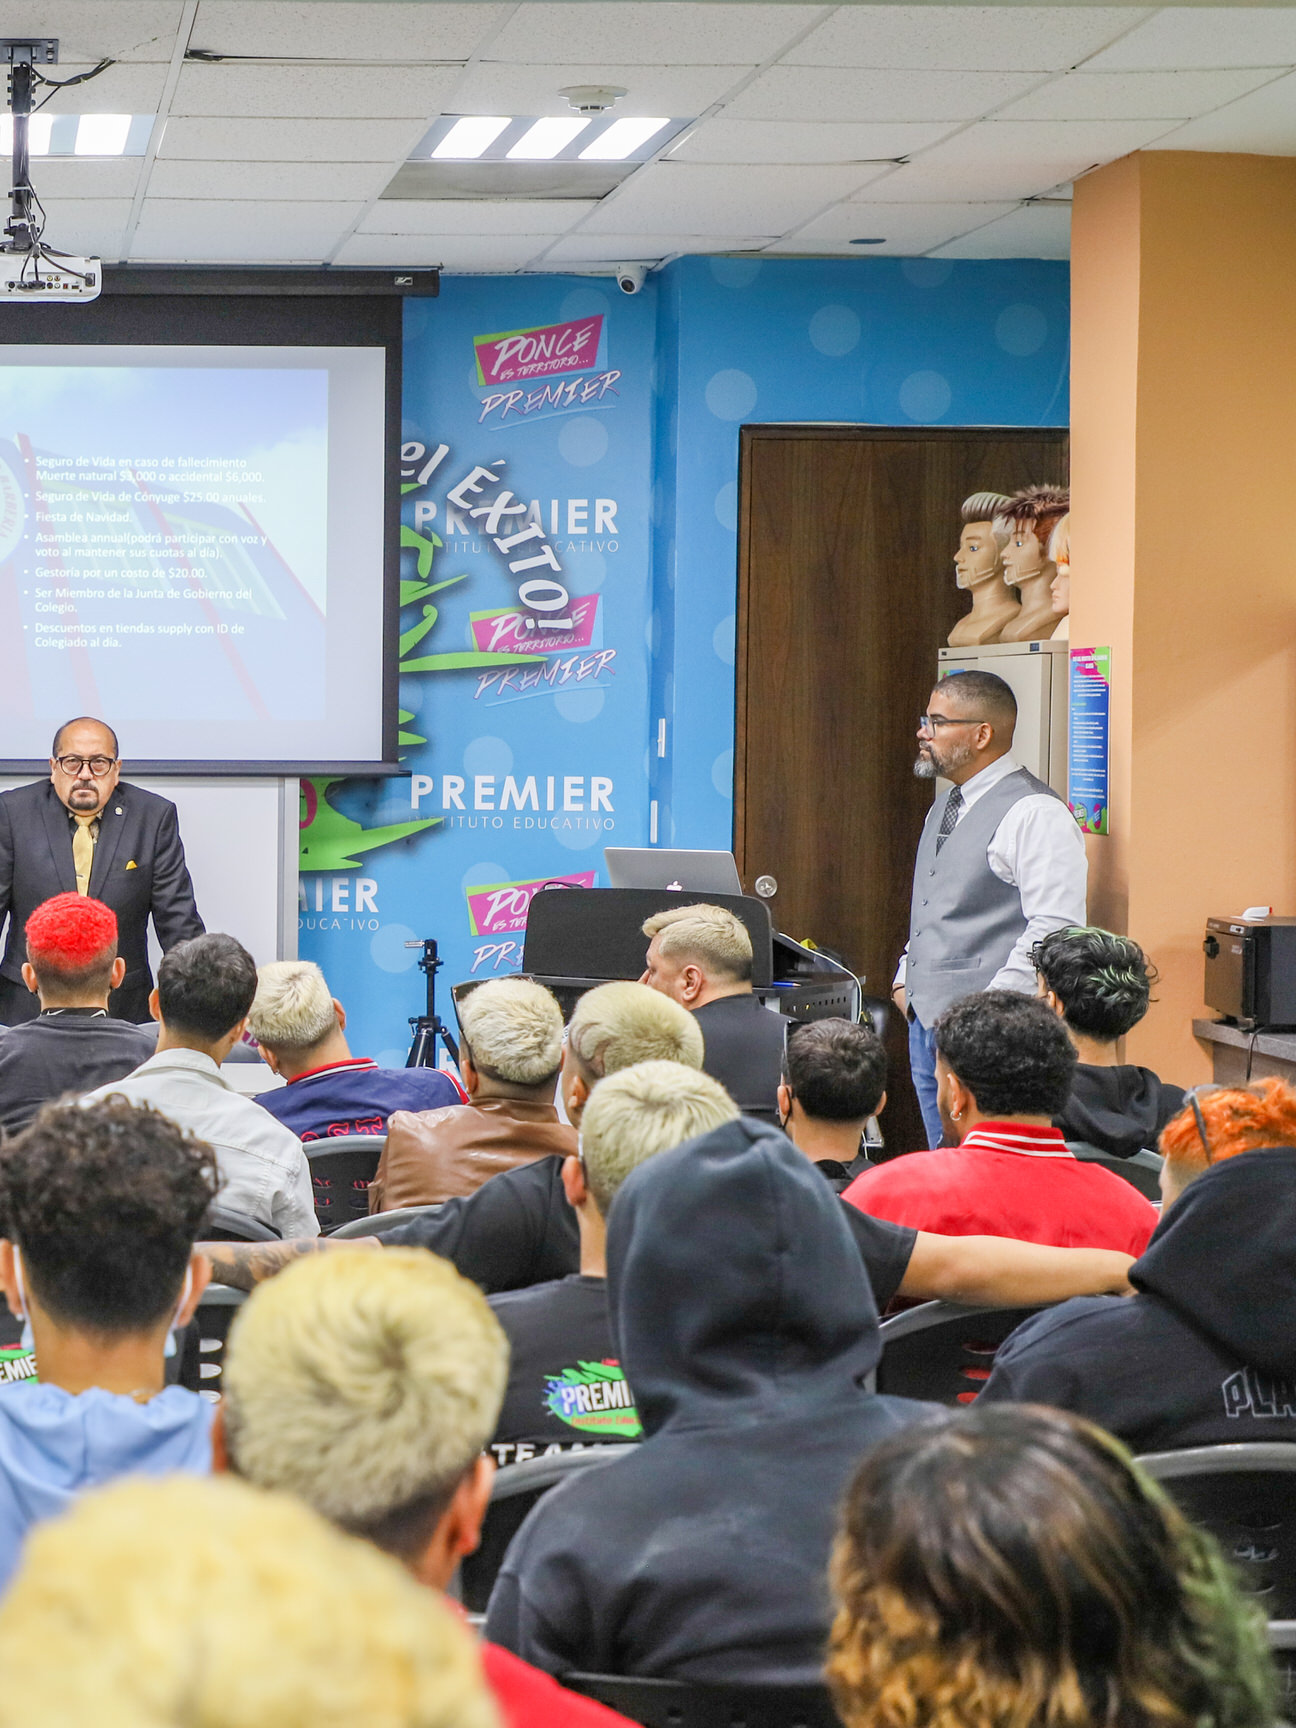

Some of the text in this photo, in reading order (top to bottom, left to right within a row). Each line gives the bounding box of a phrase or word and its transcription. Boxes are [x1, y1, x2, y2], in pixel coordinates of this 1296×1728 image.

[490, 323, 594, 376] PONCE
[500, 369, 514, 380] ES
[478, 370, 622, 424] PREMIER
[35, 456, 247, 469] Seguro de Vida en caso de fallecimiento
[36, 471, 77, 482] Muerte
[78, 471, 117, 482] natural
[168, 471, 222, 482] accidental
[35, 491, 73, 504] Seguro
[75, 491, 89, 502] de
[91, 491, 116, 502] Vida
[118, 491, 132, 502] de
[35, 512, 67, 523] Fiesta
[69, 512, 83, 523] de
[35, 533, 88, 544] Asamblea
[164, 534, 216, 546] participar
[218, 536, 238, 545] con
[240, 536, 259, 545] voz
[35, 548, 60, 557] voto
[62, 547, 72, 557] al
[74, 548, 126, 558] mantener
[129, 550, 147, 558] sus
[149, 549, 185, 558] cuotas
[187, 548, 196, 558] al
[35, 567, 80, 578] Gestoría
[83, 569, 101, 581] por
[104, 570, 118, 578] un
[120, 569, 150, 579] costo
[151, 568, 166, 579] de
[35, 588, 253, 600] Ser Miembro de la Junta de Gobierno del
[35, 602, 78, 615] Colegio.
[35, 623, 245, 637] Descuentos en tiendas supply con ID de
[35, 637, 87, 650] Colegiado
[90, 637, 100, 648] al
[473, 649, 617, 699] PREMIER
[411, 775, 615, 812] PREMIER
[513, 816, 615, 831] EDUCATIVO
[492, 919, 507, 931] ES
[561, 1379, 635, 1415] PREMI
